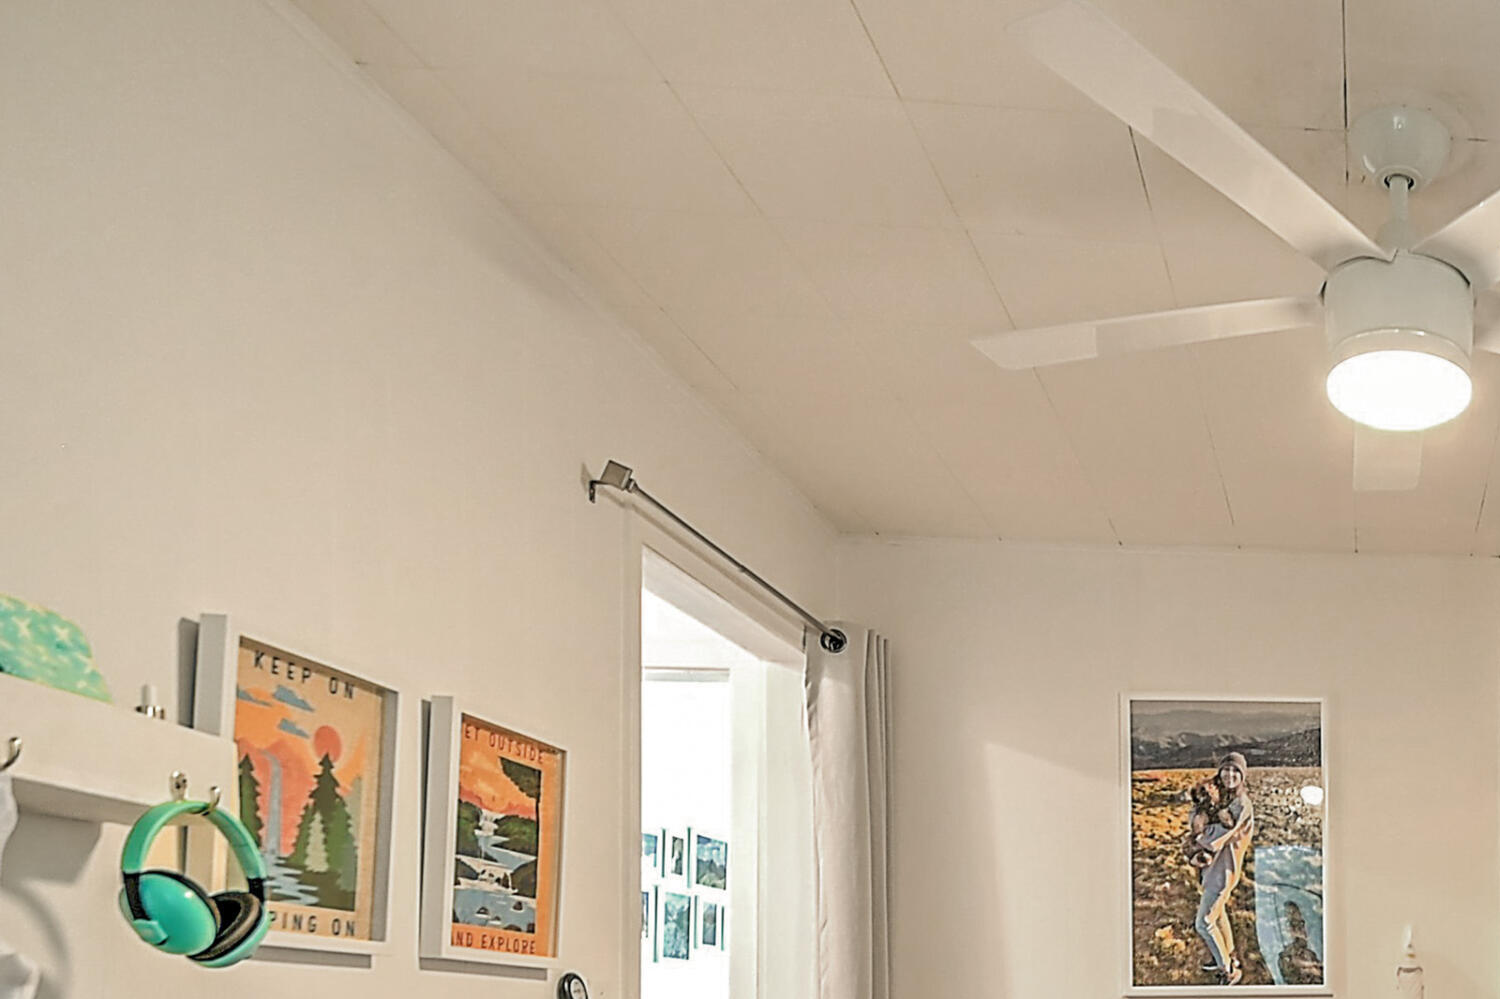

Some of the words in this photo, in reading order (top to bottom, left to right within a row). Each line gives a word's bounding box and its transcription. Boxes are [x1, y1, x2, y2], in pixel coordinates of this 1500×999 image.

[254, 650, 312, 684] KEEP
[329, 677, 355, 699] ON
[489, 732, 545, 764] OUTSIDE
[332, 918, 355, 936] ON
[451, 931, 473, 947] ND
[481, 934, 536, 954] EXPLORE
